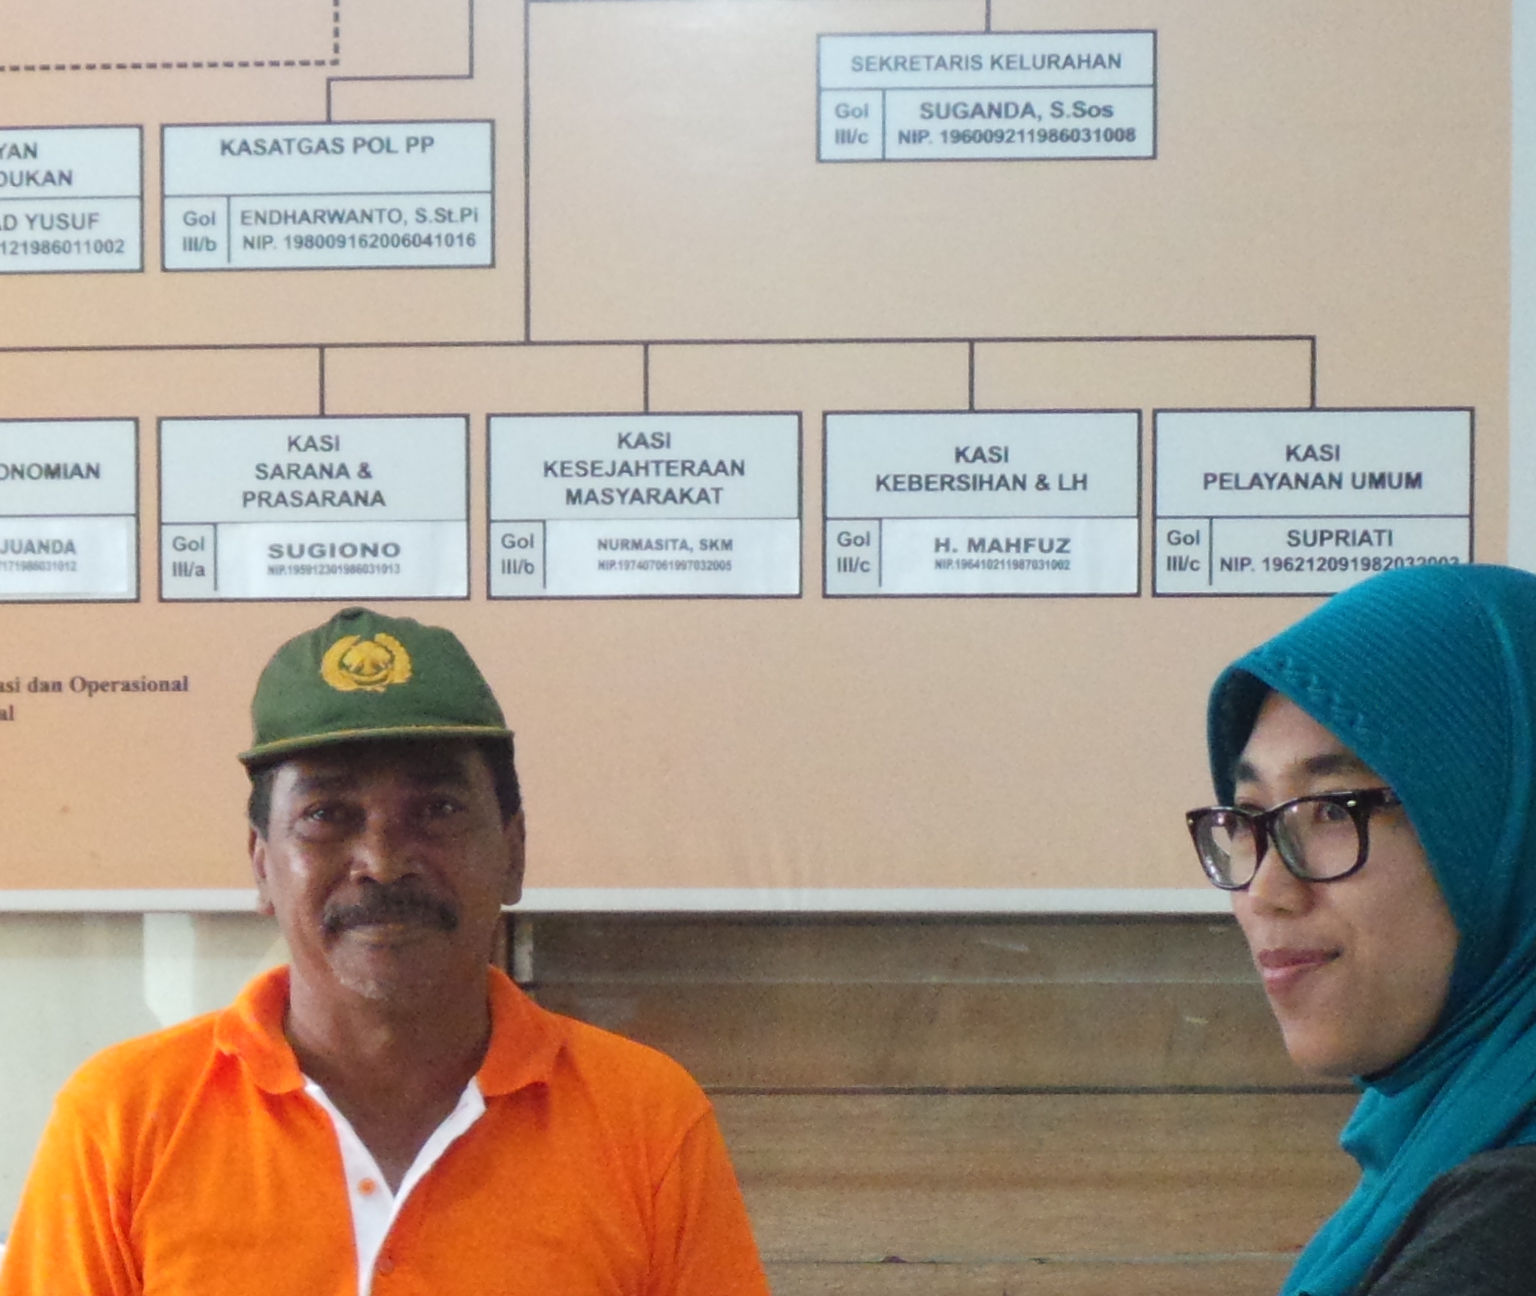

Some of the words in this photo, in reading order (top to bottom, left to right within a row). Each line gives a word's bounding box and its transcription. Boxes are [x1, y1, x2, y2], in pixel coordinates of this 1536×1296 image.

[852, 54, 983, 72] SEKRETARIS
[991, 53, 1121, 70] KELURAHAN
[835, 103, 869, 119] Gol
[921, 102, 1042, 121] SUGANDA,
[1050, 101, 1114, 119] S.Sos
[898, 130, 931, 144] NIP.
[221, 137, 344, 156] KASATGAS
[353, 137, 398, 154] POL
[406, 136, 434, 153] PP
[25, 213, 99, 231] YUSUF
[183, 211, 216, 227] Gol
[241, 208, 407, 225] ENDHARWANTO,
[243, 235, 276, 249] NIP.
[288, 435, 339, 452] KASI
[618, 432, 670, 449] KASI
[955, 446, 1008, 463] KASI
[1286, 444, 1340, 462] KASI
[256, 463, 350, 480] SARANA
[357, 463, 372, 479] &
[544, 460, 745, 477] KESEJAHTERAAN
[876, 474, 1026, 491] KEBERSIHAN
[1035, 474, 1050, 491] &
[1059, 474, 1087, 491] LH
[1204, 472, 1342, 490] PELAYANAN
[1352, 472, 1422, 489] UMUM
[243, 490, 386, 507] PRASARANA
[566, 488, 723, 505] MASYARAKAT
[0, 539, 76, 554] JUANDA
[172, 536, 205, 552] Gol
[501, 533, 534, 549] Gol
[598, 539, 693, 553] NURMASITA,
[700, 539, 733, 551] SKM
[837, 531, 870, 547] Gol
[935, 538, 957, 553] H.
[968, 538, 1070, 553] MAHFUZ
[1167, 530, 1200, 546] Gol
[1287, 529, 1392, 547] SUPRIATI
[269, 543, 400, 559] SUGIONO
[1167, 556, 1200, 571] III/c
[1220, 557, 1255, 572] NIP.
[27, 677, 62, 693] dan
[69, 676, 188, 697] Operasional
